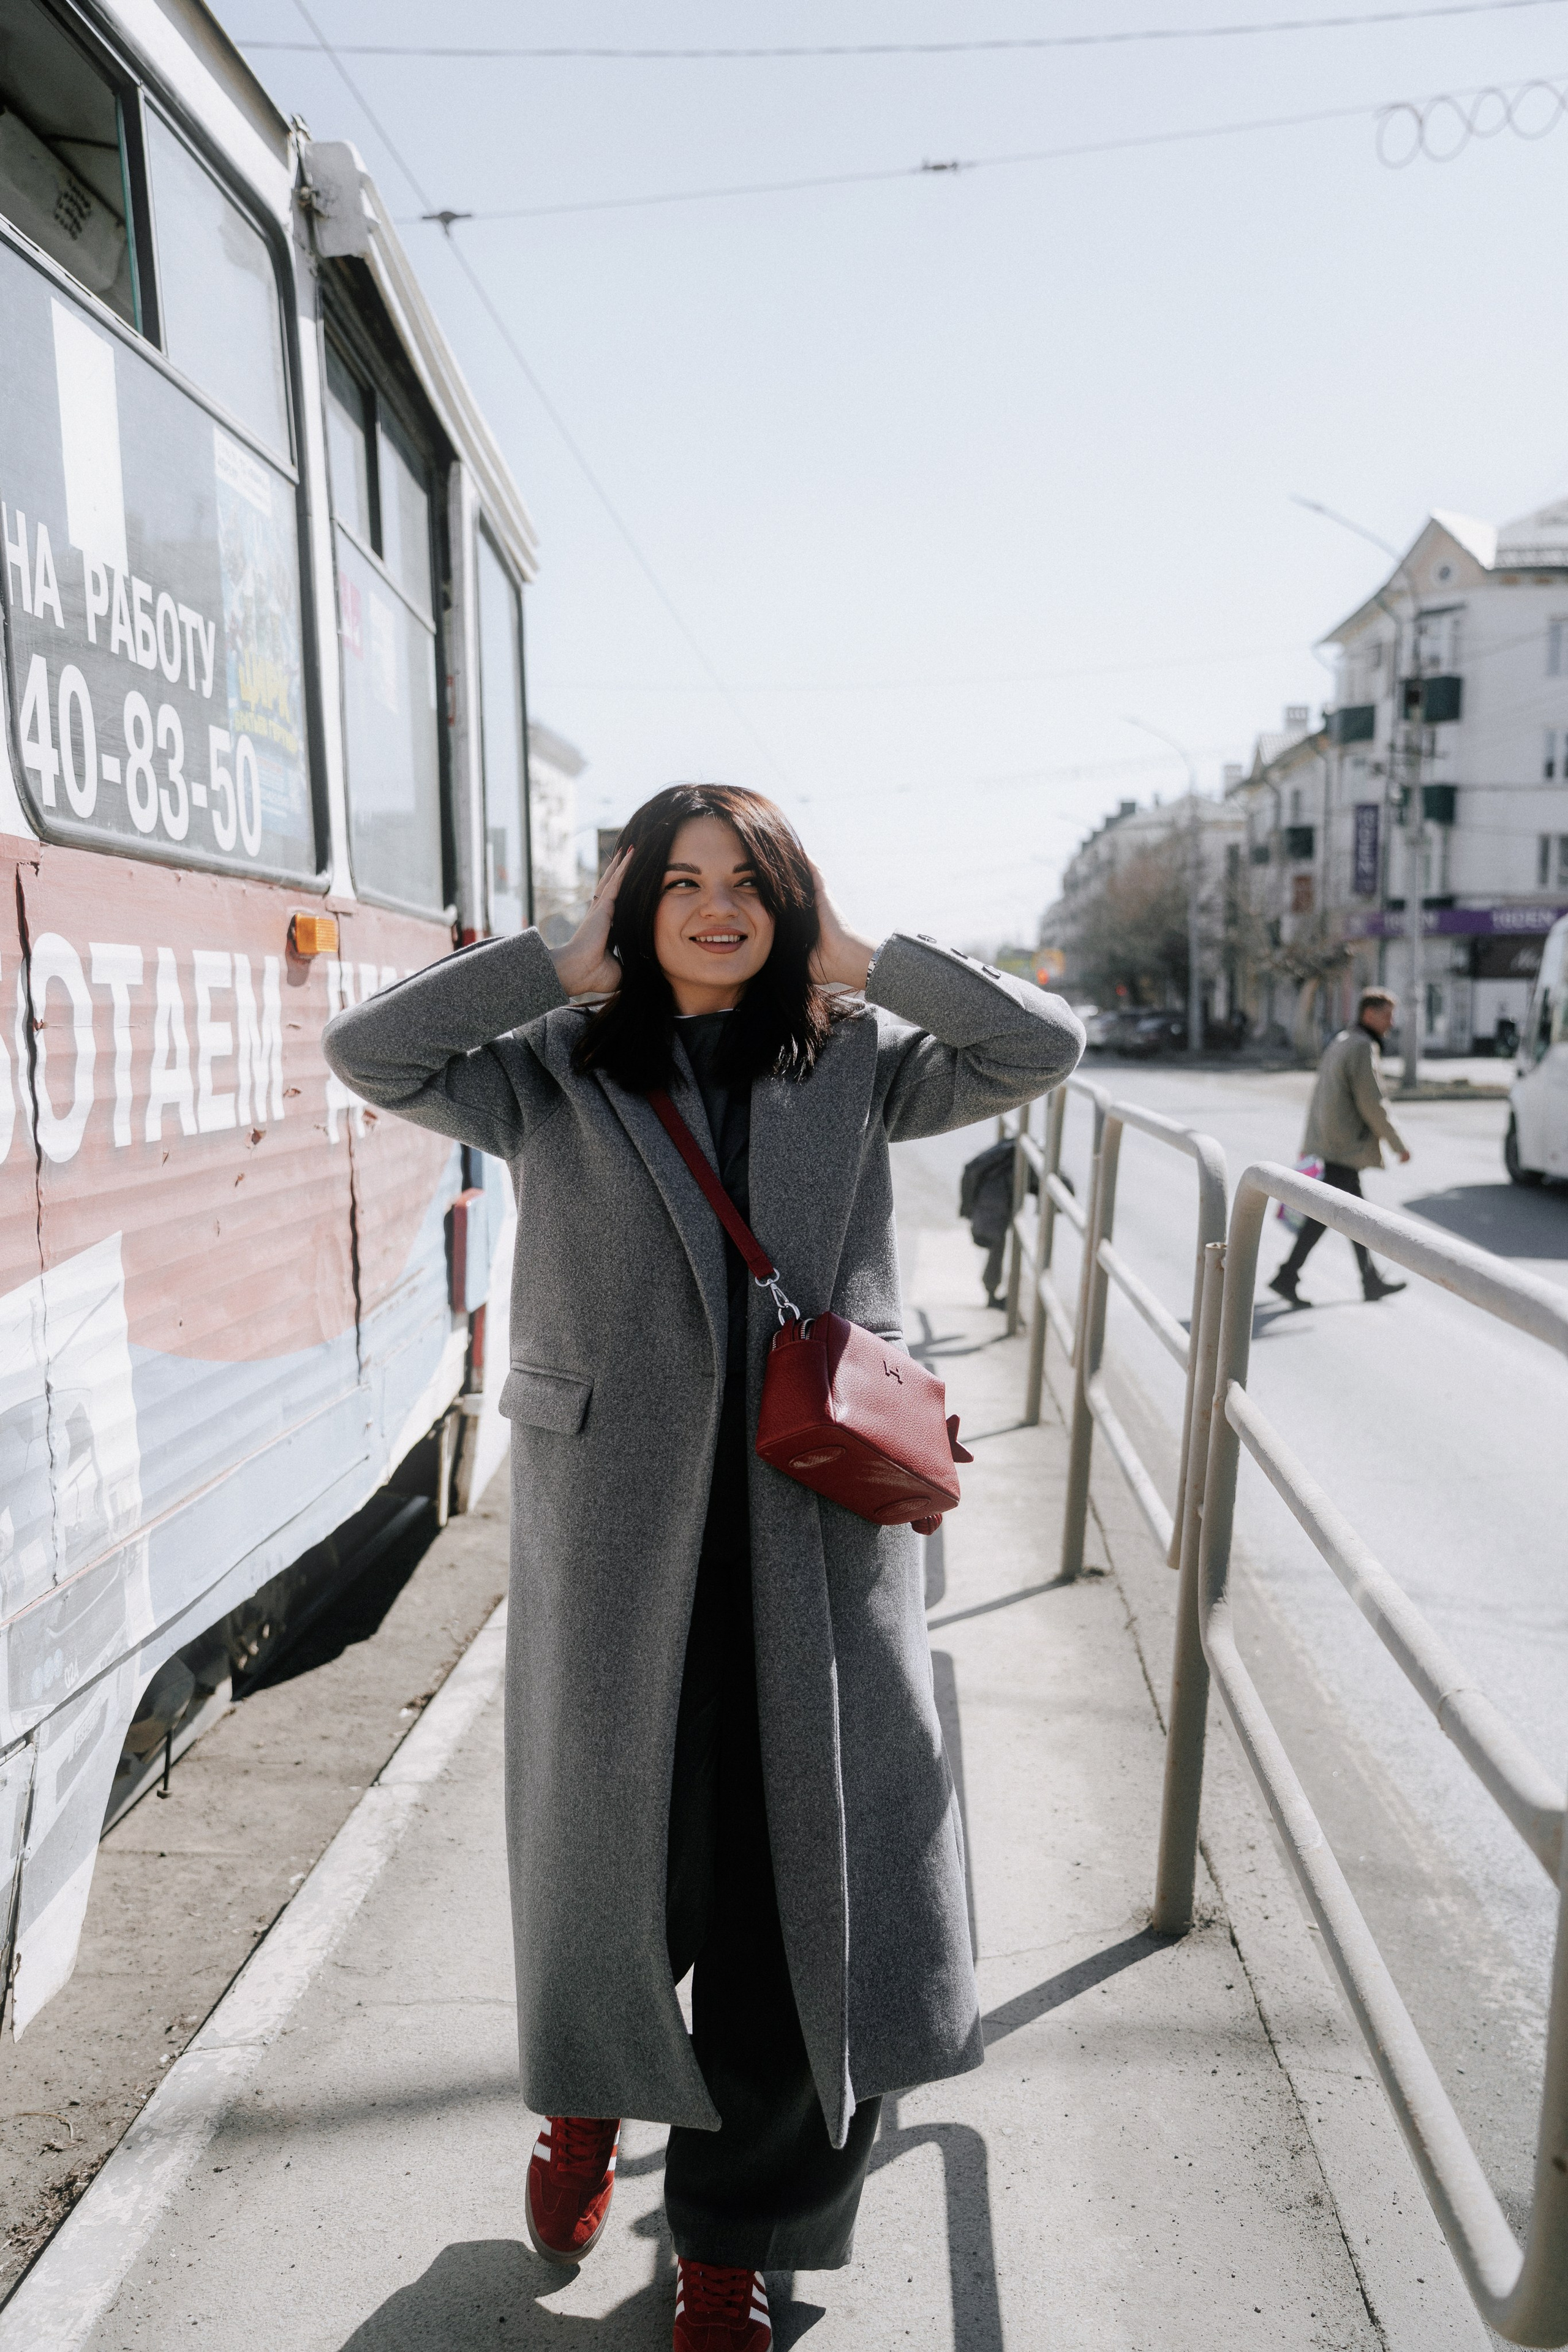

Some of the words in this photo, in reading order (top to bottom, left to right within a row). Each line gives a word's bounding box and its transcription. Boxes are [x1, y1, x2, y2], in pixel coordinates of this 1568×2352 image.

[2, 501, 65, 629] НА
[82, 549, 216, 699] РАБОТУ
[20, 653, 262, 857] 40-83-50
